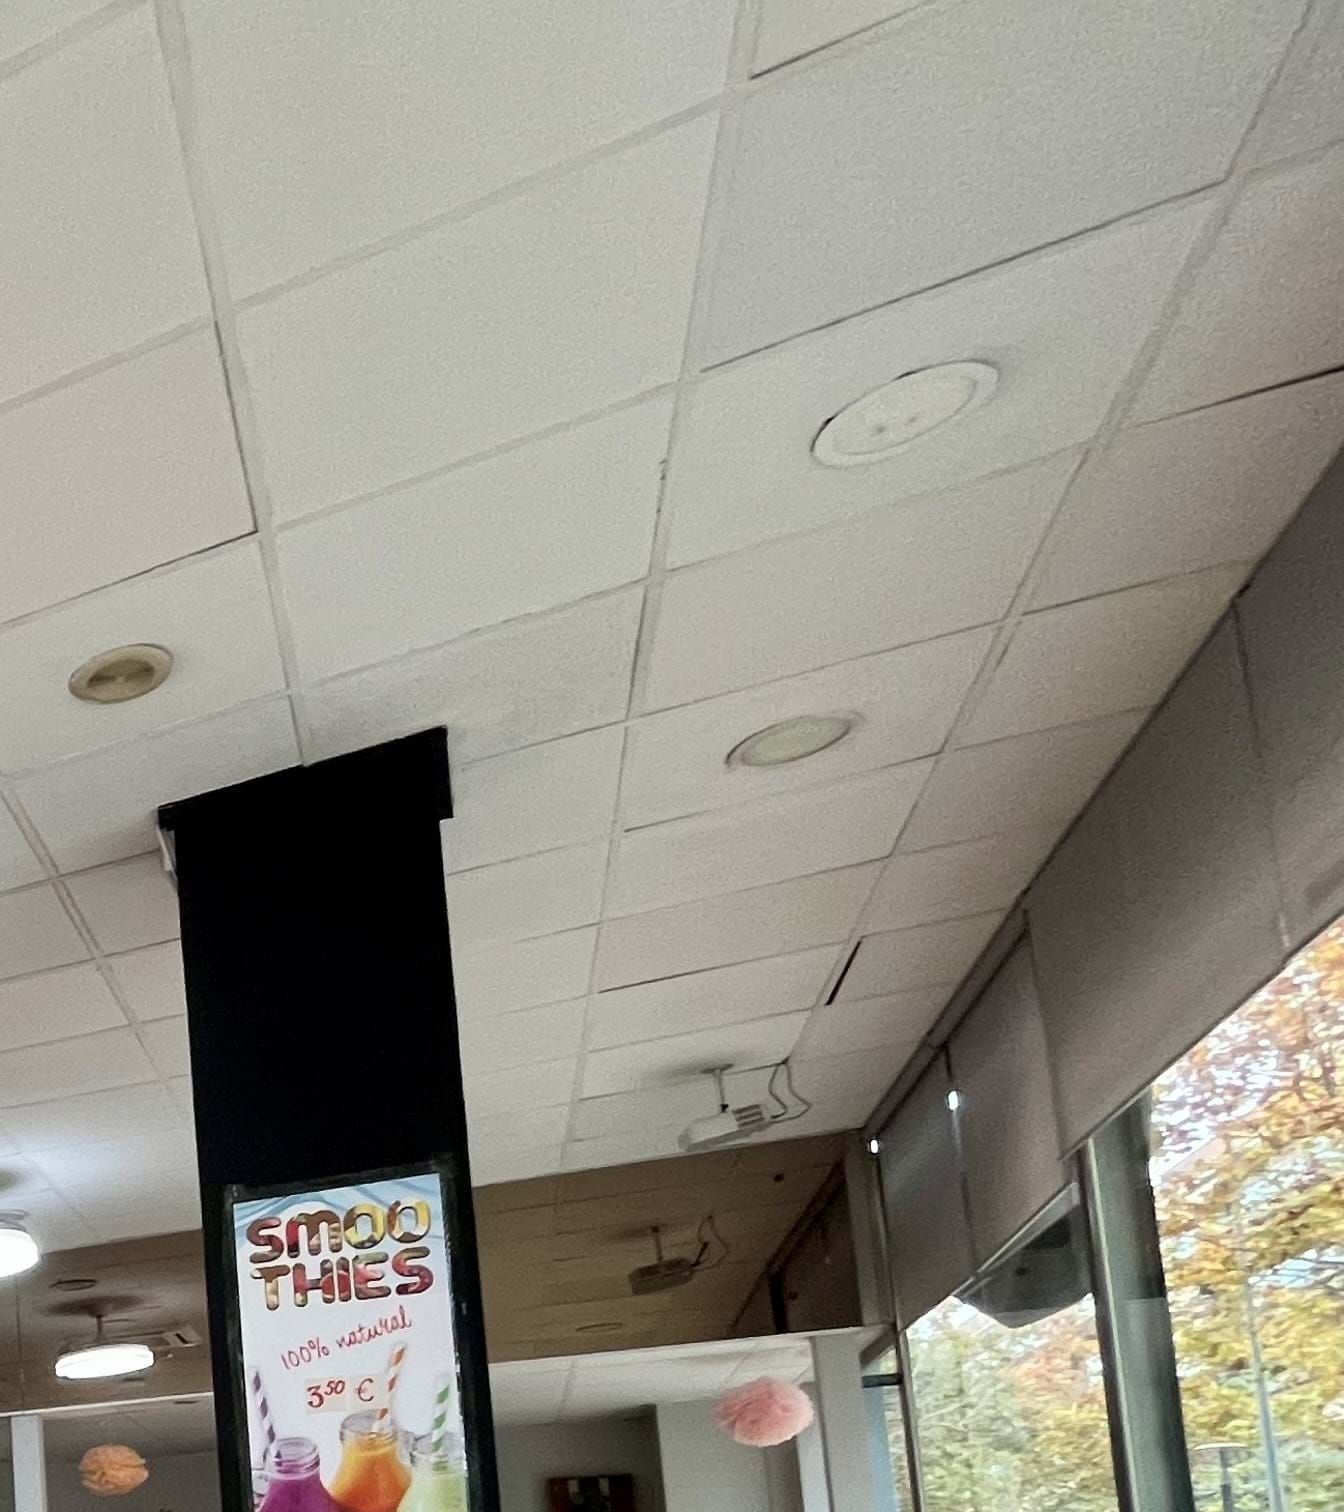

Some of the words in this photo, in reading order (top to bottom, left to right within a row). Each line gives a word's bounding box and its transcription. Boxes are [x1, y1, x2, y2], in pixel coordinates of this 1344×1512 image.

[246, 1200, 432, 1264] SMOO
[250, 1246, 434, 1311] THIES
[280, 1337, 330, 1370] 100%
[336, 1305, 412, 1348] natural
